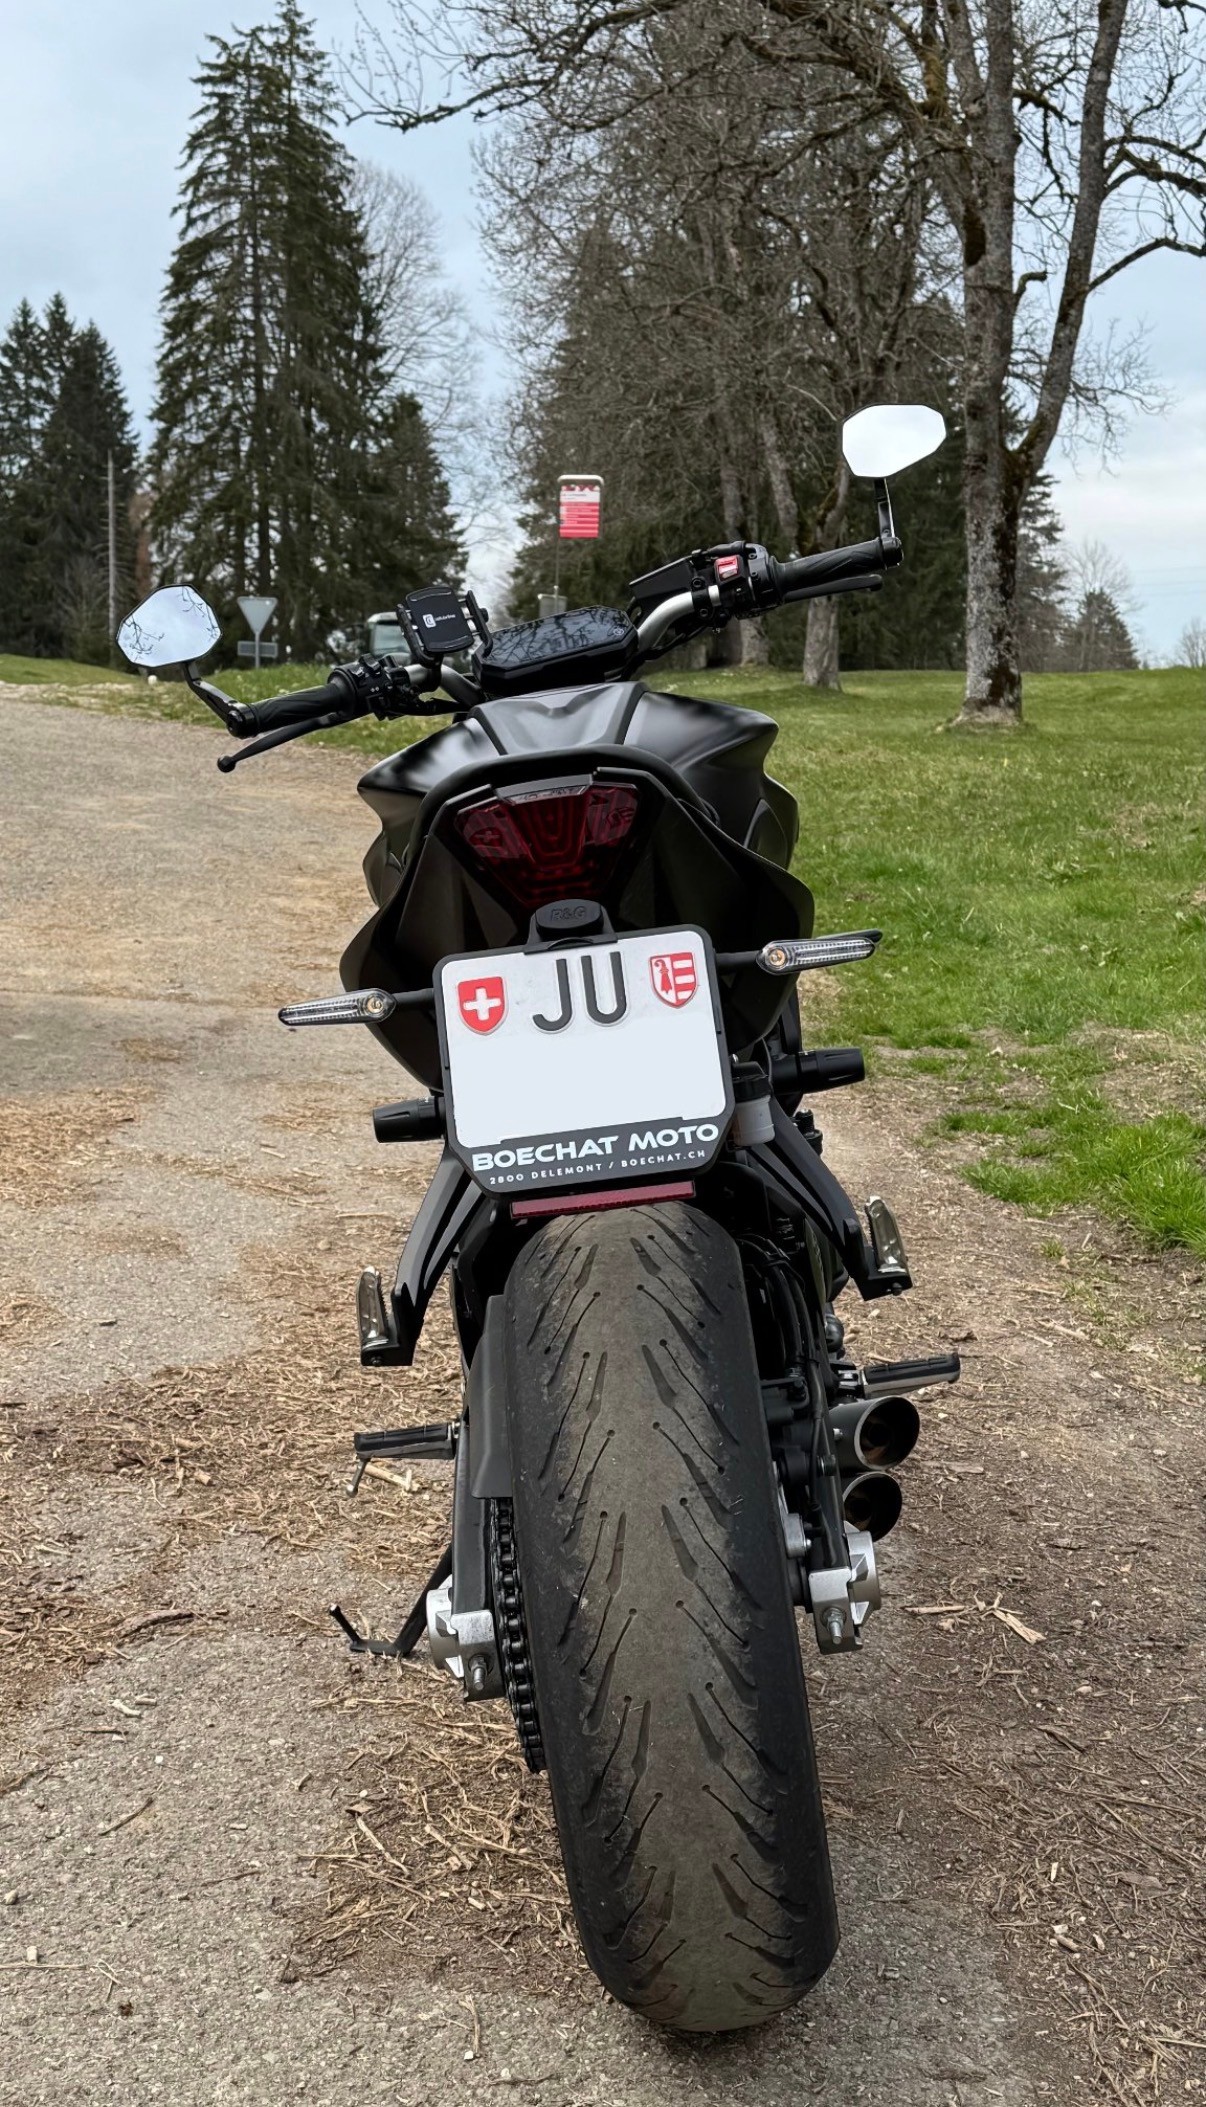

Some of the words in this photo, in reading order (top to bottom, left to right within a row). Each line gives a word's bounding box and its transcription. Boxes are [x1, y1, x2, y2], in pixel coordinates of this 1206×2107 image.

[551, 905, 587, 920] R&G
[532, 951, 627, 1032] JU
[472, 1135, 619, 1171] BOECHAT
[628, 1123, 719, 1152] MOTO
[489, 1173, 524, 1185] 2800
[531, 1163, 602, 1179] DELEMONT
[608, 1161, 614, 1169] /
[621, 1149, 706, 1168] BOECHAT.CH
